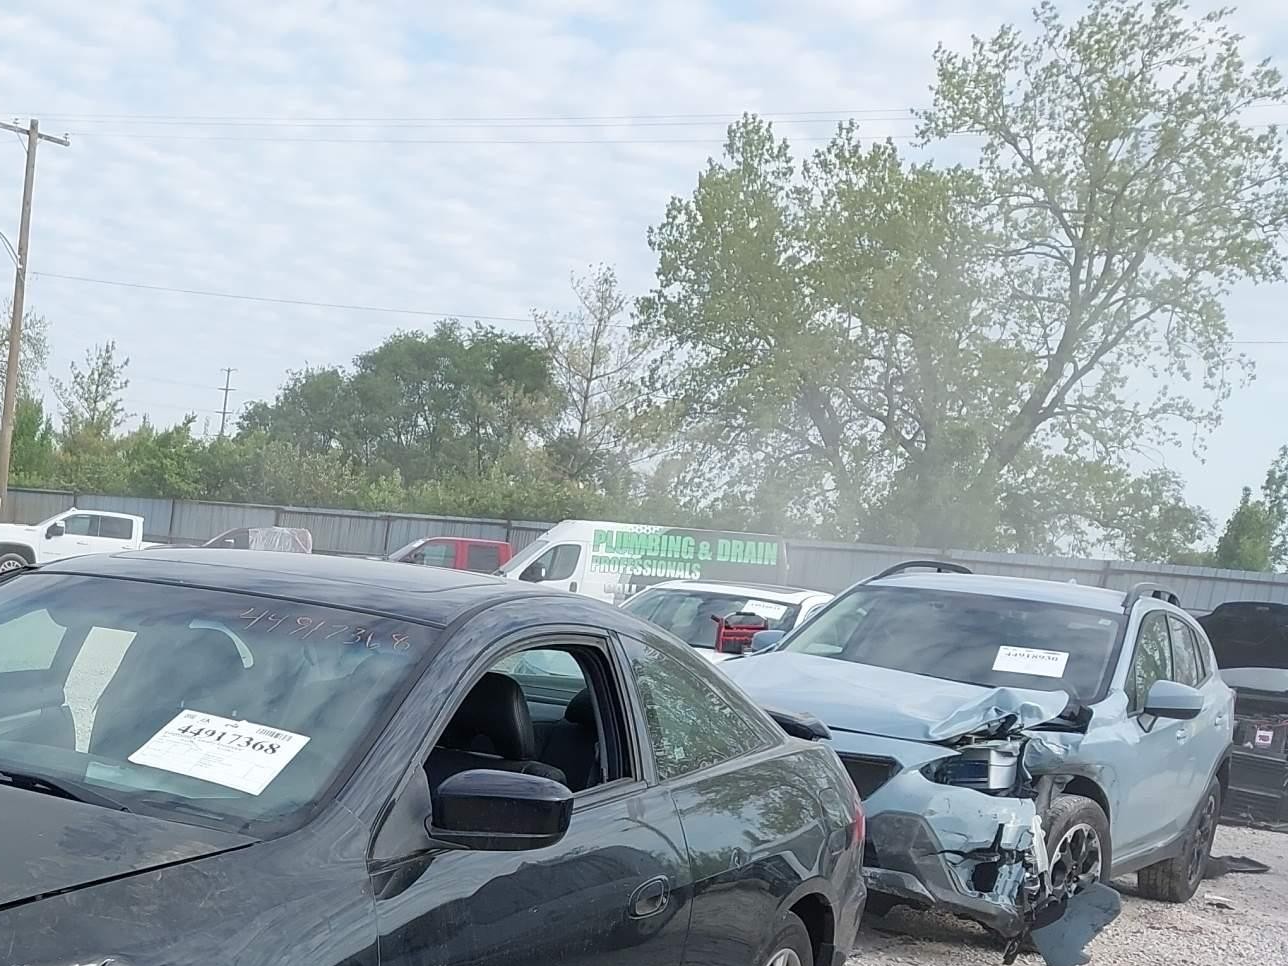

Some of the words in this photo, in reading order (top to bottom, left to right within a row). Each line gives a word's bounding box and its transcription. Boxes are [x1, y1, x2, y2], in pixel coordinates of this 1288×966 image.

[592, 529, 696, 559] PLUMBING
[697, 540, 712, 561] &
[717, 538, 778, 566] DRAIN
[591, 555, 701, 580] PROFESSIONALS
[177, 724, 281, 755] 44917368
